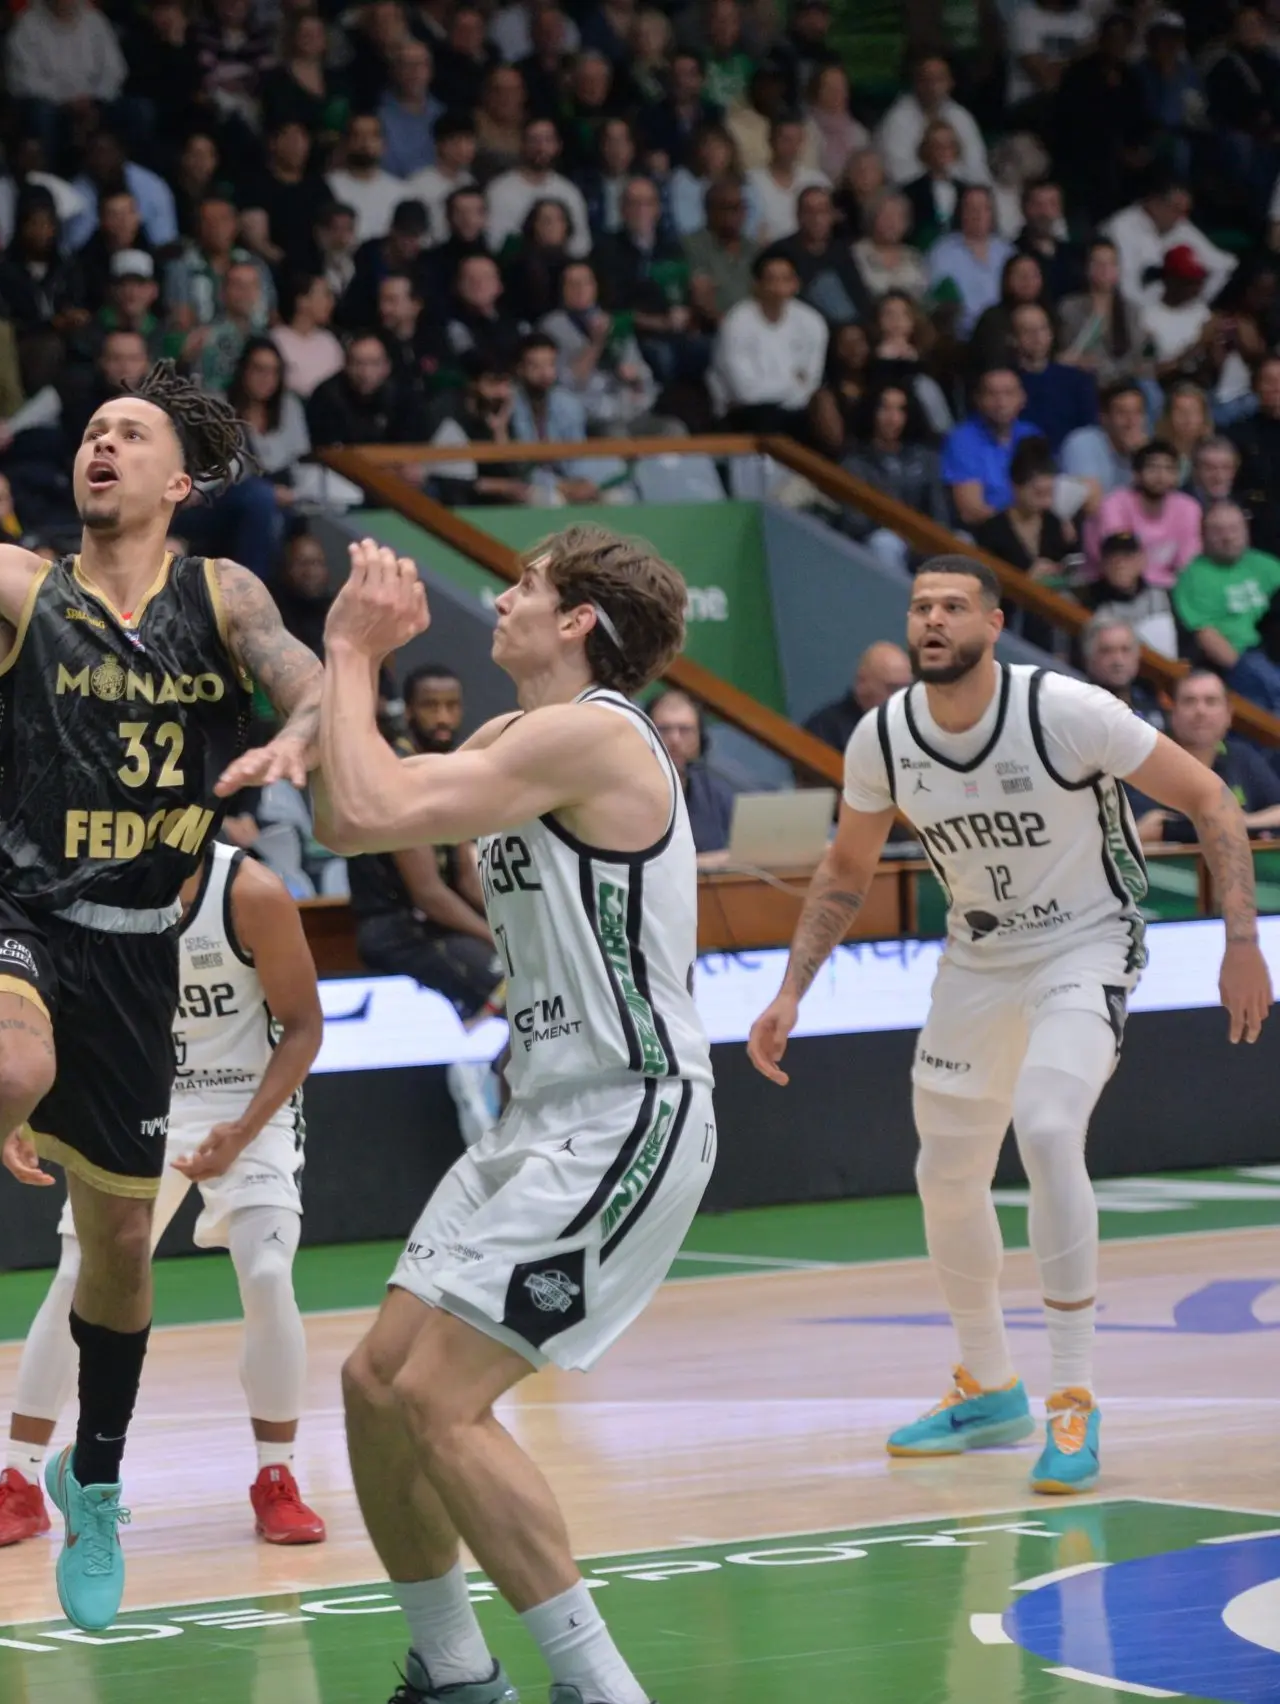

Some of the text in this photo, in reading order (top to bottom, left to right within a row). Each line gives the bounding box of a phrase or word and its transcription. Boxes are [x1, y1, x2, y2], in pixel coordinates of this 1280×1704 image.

[117, 721, 185, 788] 32
[923, 811, 1051, 855] NTR92
[985, 864, 1019, 902] 12
